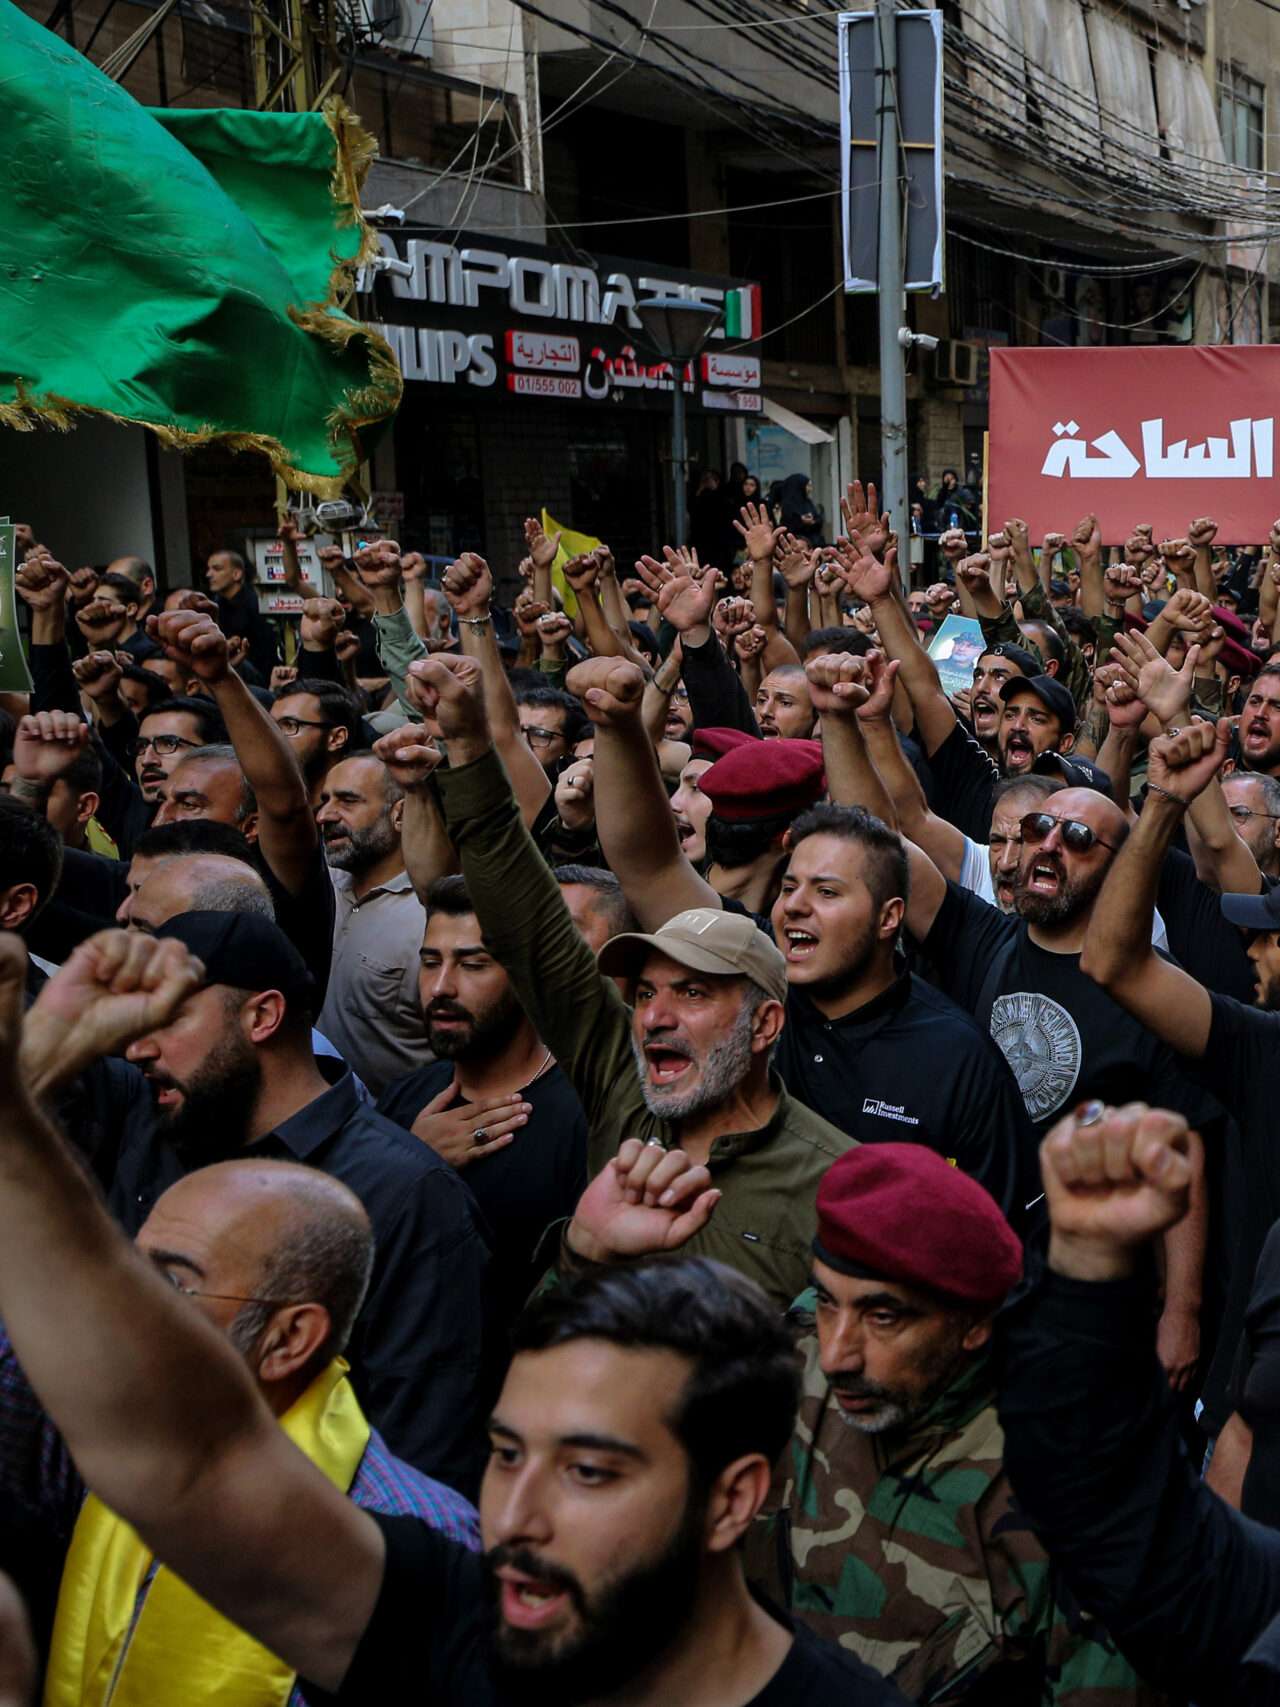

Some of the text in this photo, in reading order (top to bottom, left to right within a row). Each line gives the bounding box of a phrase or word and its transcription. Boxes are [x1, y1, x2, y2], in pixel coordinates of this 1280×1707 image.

[517, 336, 577, 366] التجارية
[711, 358, 757, 383] مؤسسة
[1040, 417, 1275, 478] الساحة
[878, 1109, 919, 1125] Investments
[880, 1101, 905, 1114] Russell
